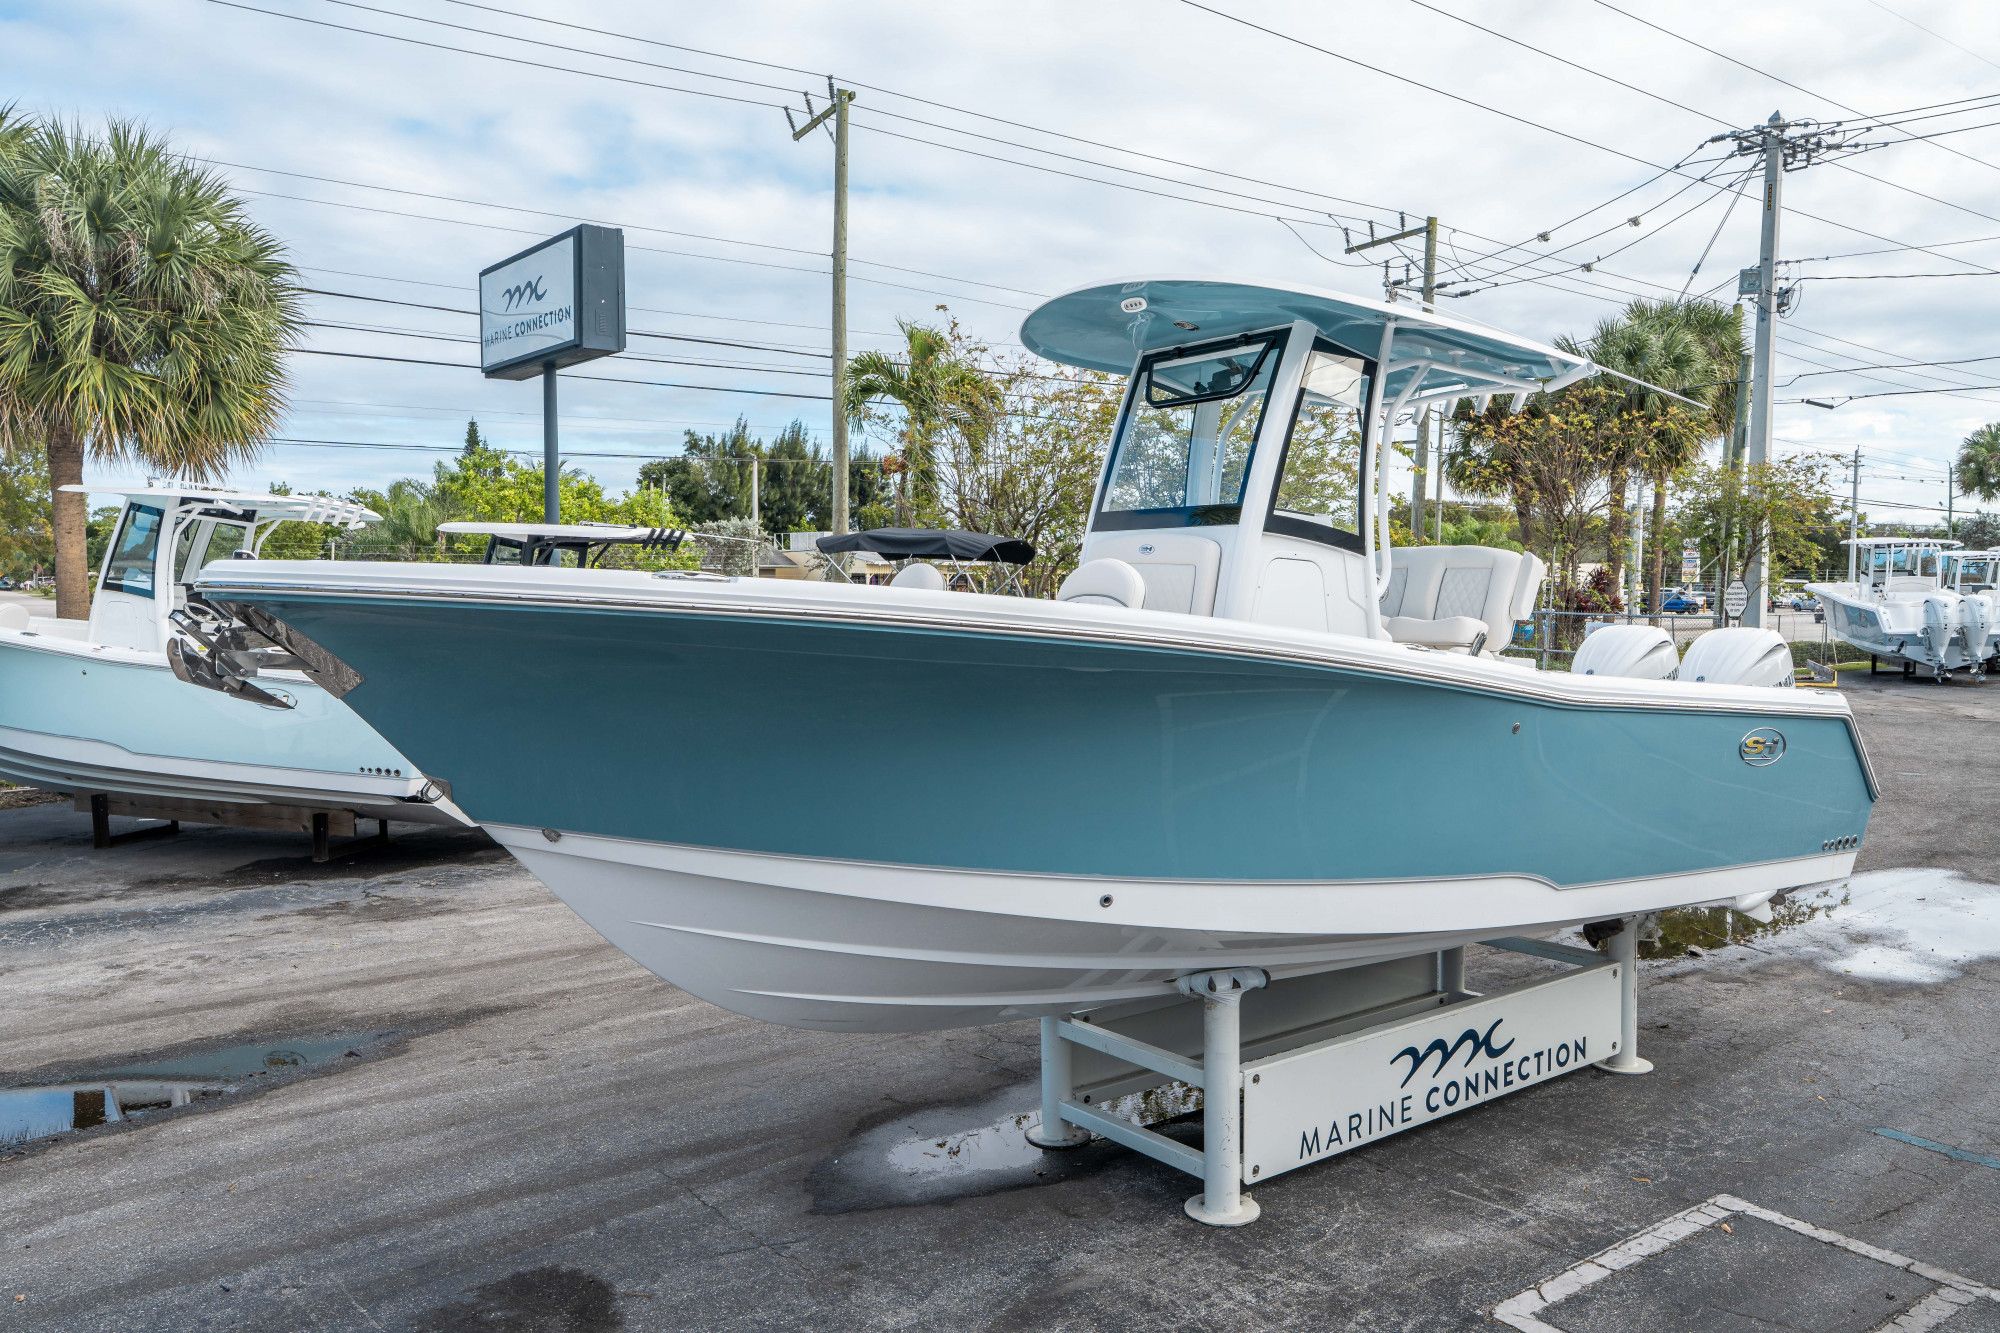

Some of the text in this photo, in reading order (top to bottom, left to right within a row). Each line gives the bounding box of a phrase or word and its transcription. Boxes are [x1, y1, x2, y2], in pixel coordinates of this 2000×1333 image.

[485, 305, 571, 348] MARINE CONNECTION
[1299, 1036, 1587, 1159] MARINE CONNECTION
